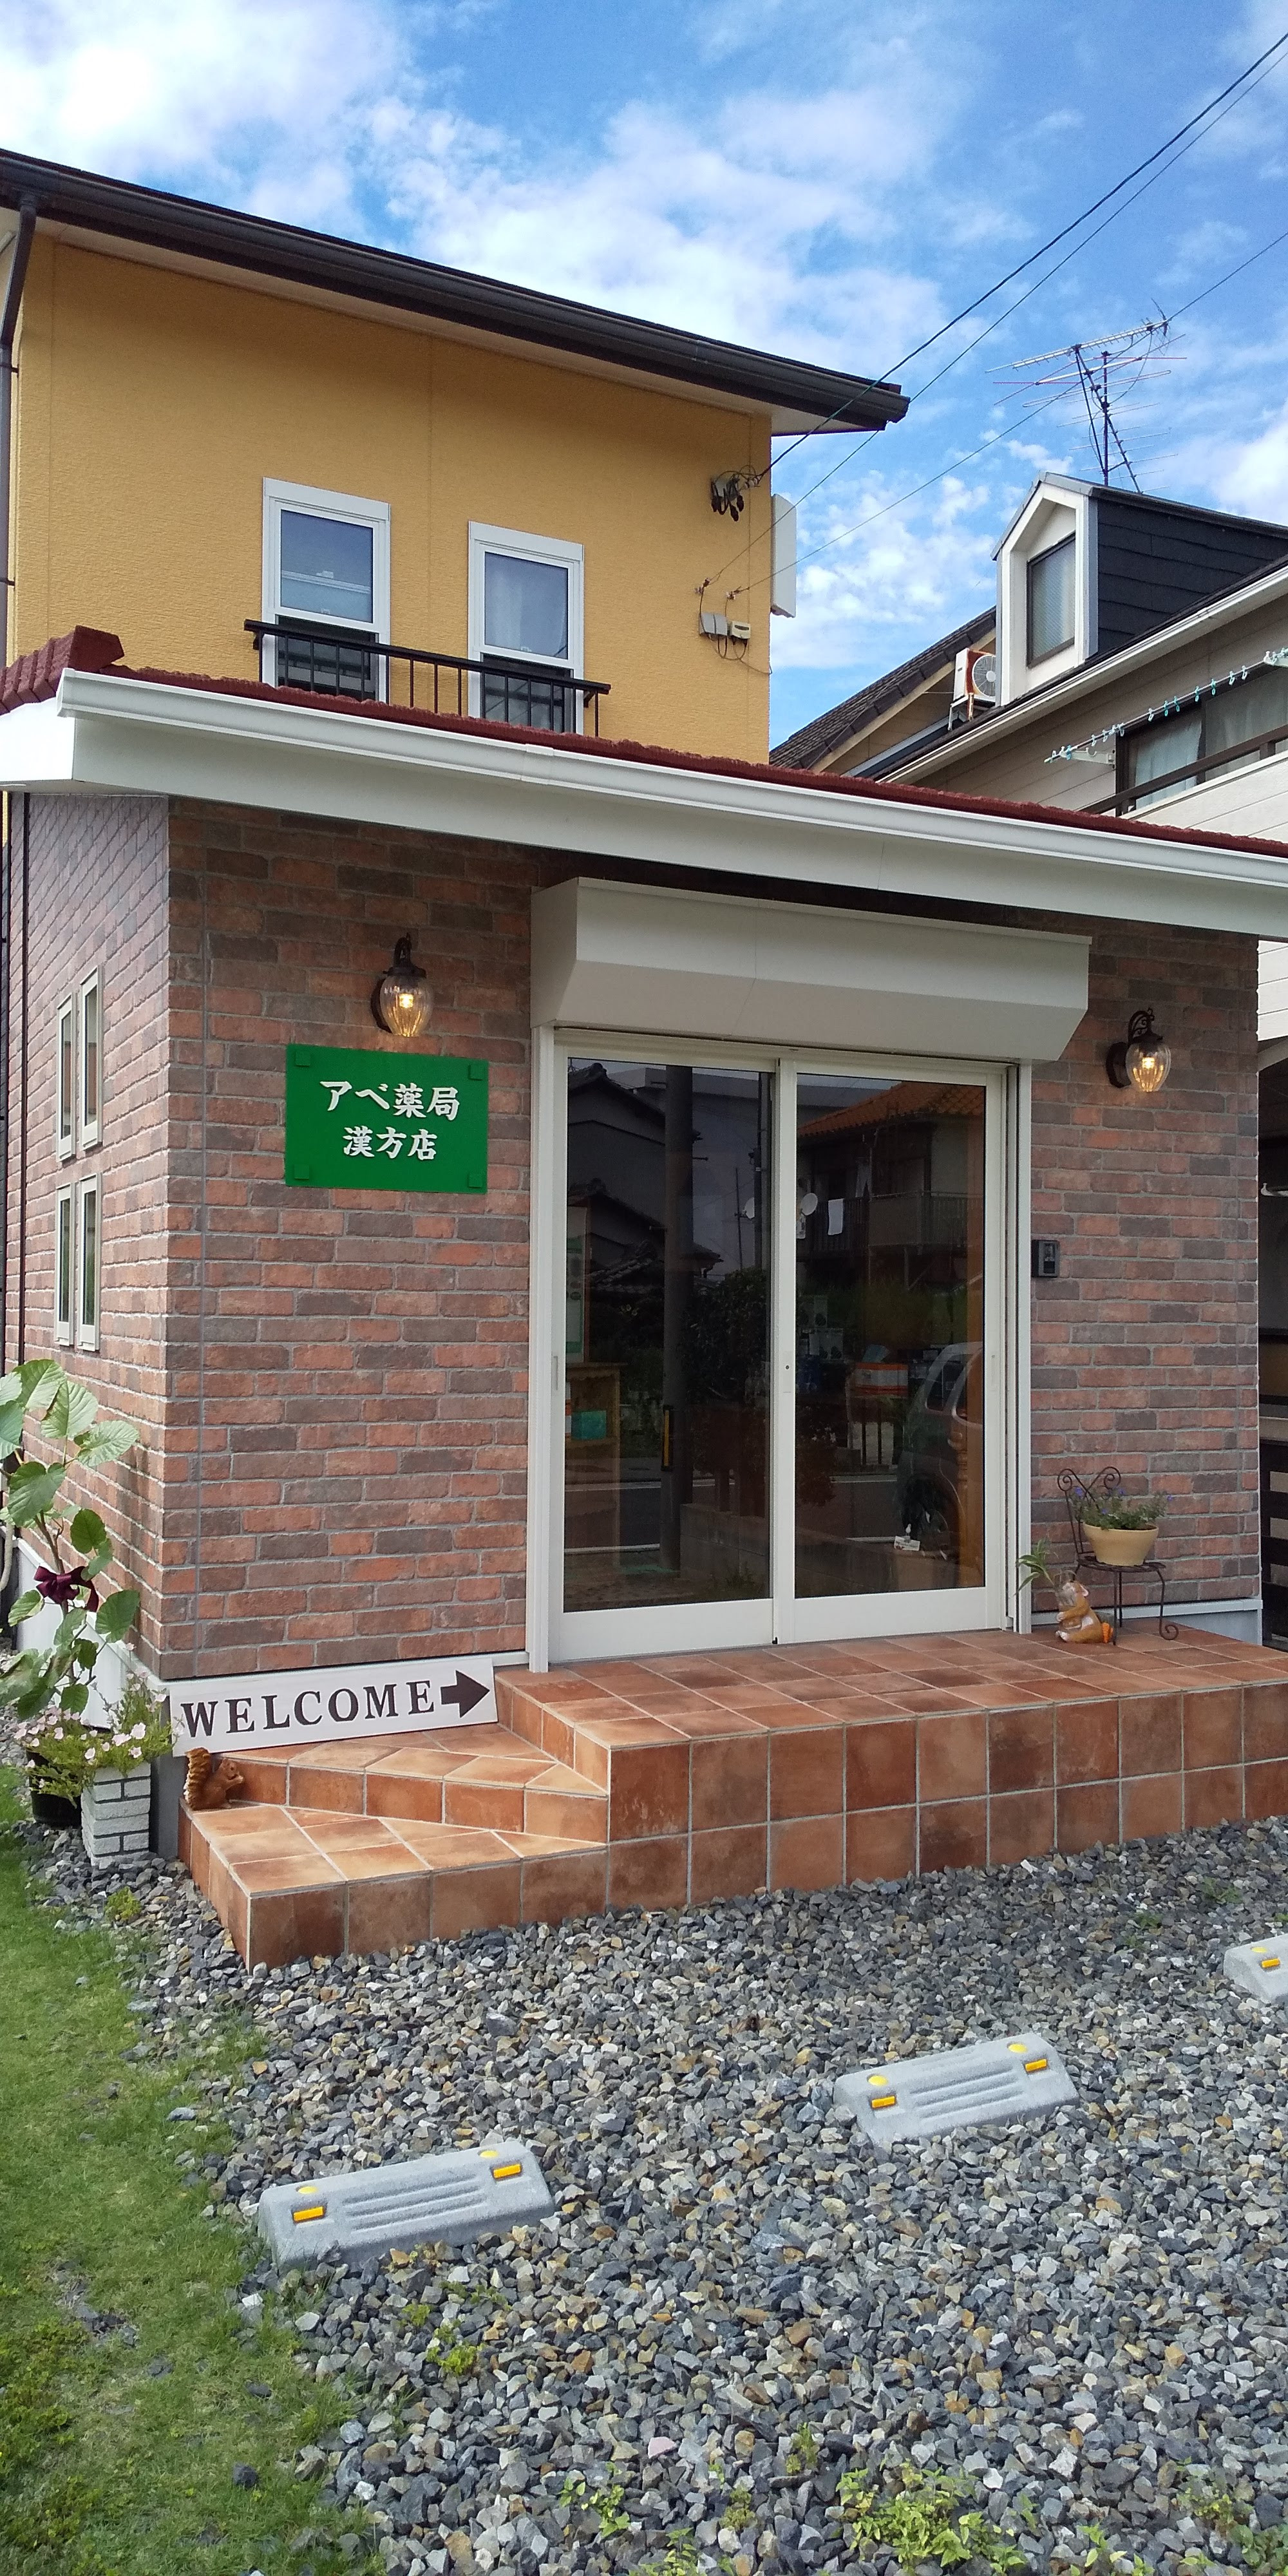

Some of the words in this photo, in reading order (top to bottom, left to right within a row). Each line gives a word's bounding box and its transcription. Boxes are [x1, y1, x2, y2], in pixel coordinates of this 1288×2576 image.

[319, 1081, 460, 1121] アベ薬局
[343, 1125, 438, 1160] 漢方店
[180, 1680, 434, 1738] WELCOME
